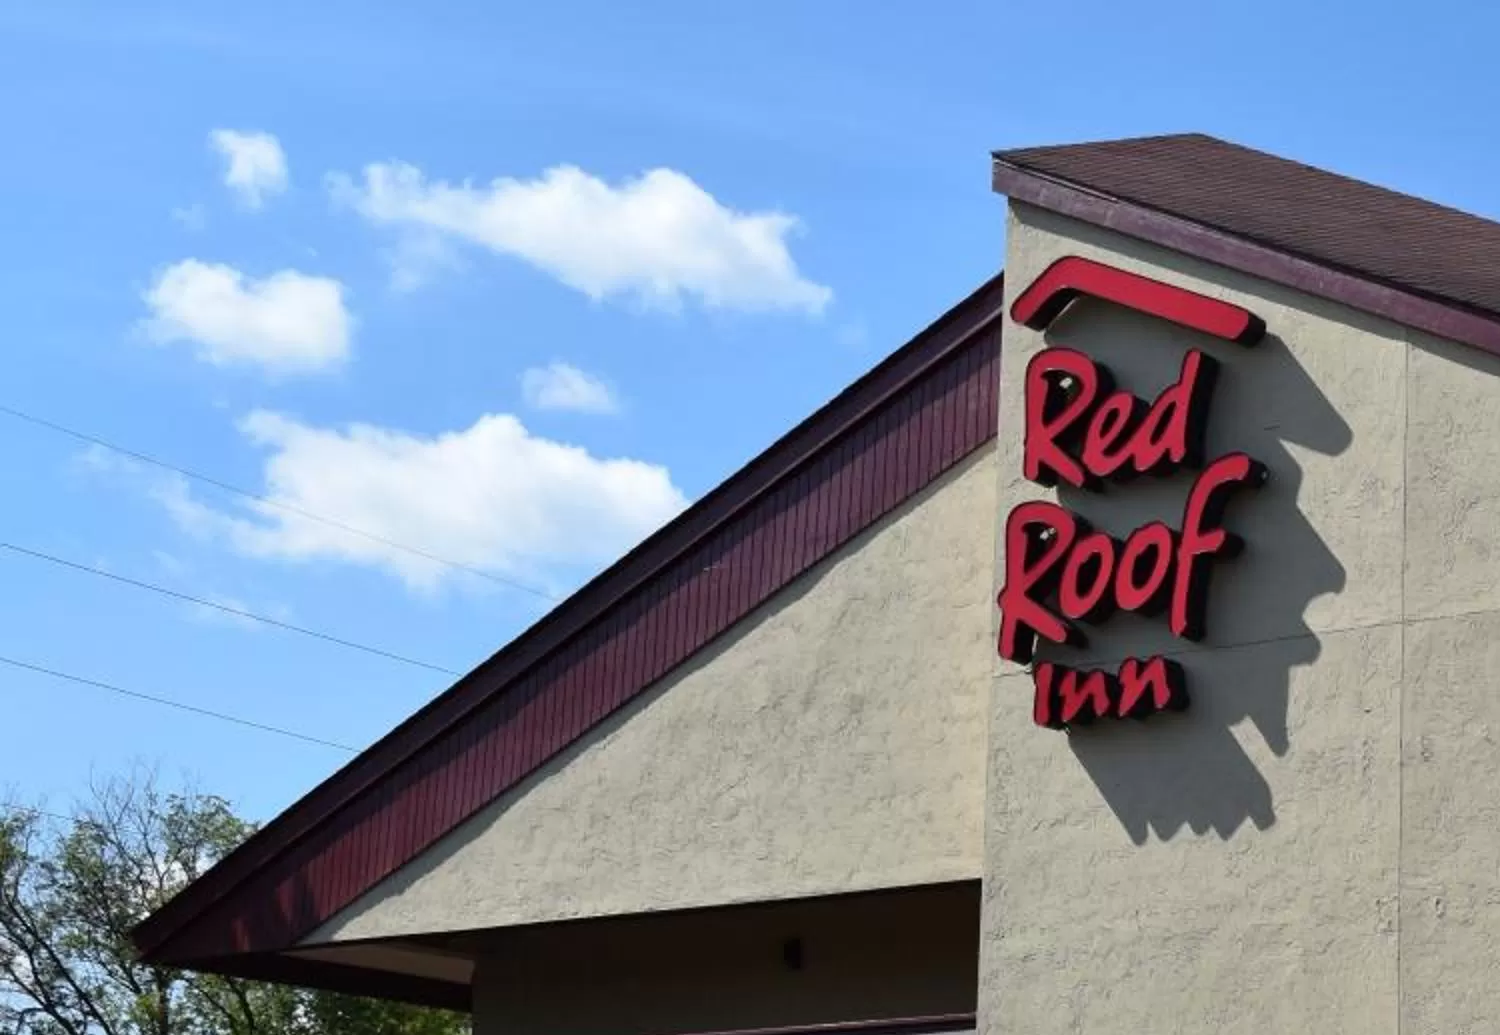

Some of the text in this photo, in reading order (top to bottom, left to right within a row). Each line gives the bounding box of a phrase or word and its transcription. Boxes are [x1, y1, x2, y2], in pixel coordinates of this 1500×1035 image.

[1023, 347, 1203, 488] Red
[997, 452, 1254, 661] Roof
[1033, 654, 1172, 728] Inn
